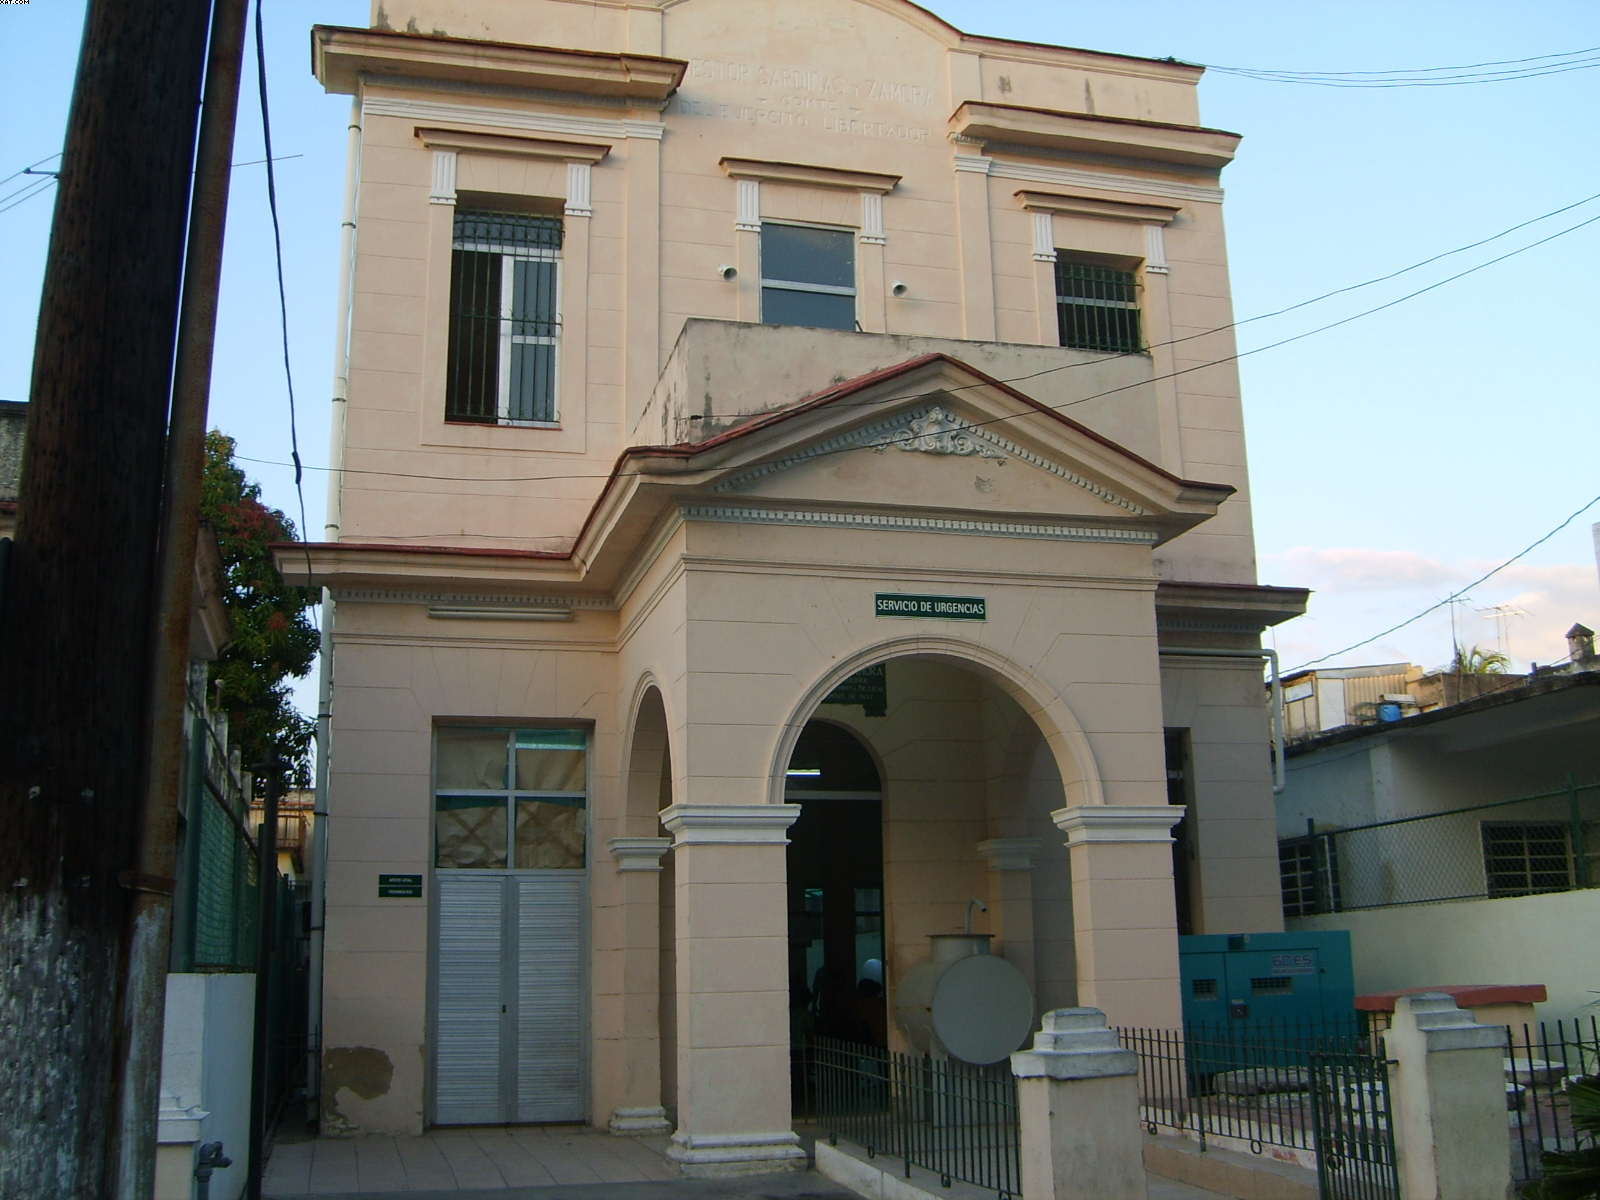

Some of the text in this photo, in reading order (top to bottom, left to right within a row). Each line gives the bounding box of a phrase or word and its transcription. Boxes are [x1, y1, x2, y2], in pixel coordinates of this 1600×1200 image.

[877, 600, 984, 614] SERVICIO DE URGENCIAS
